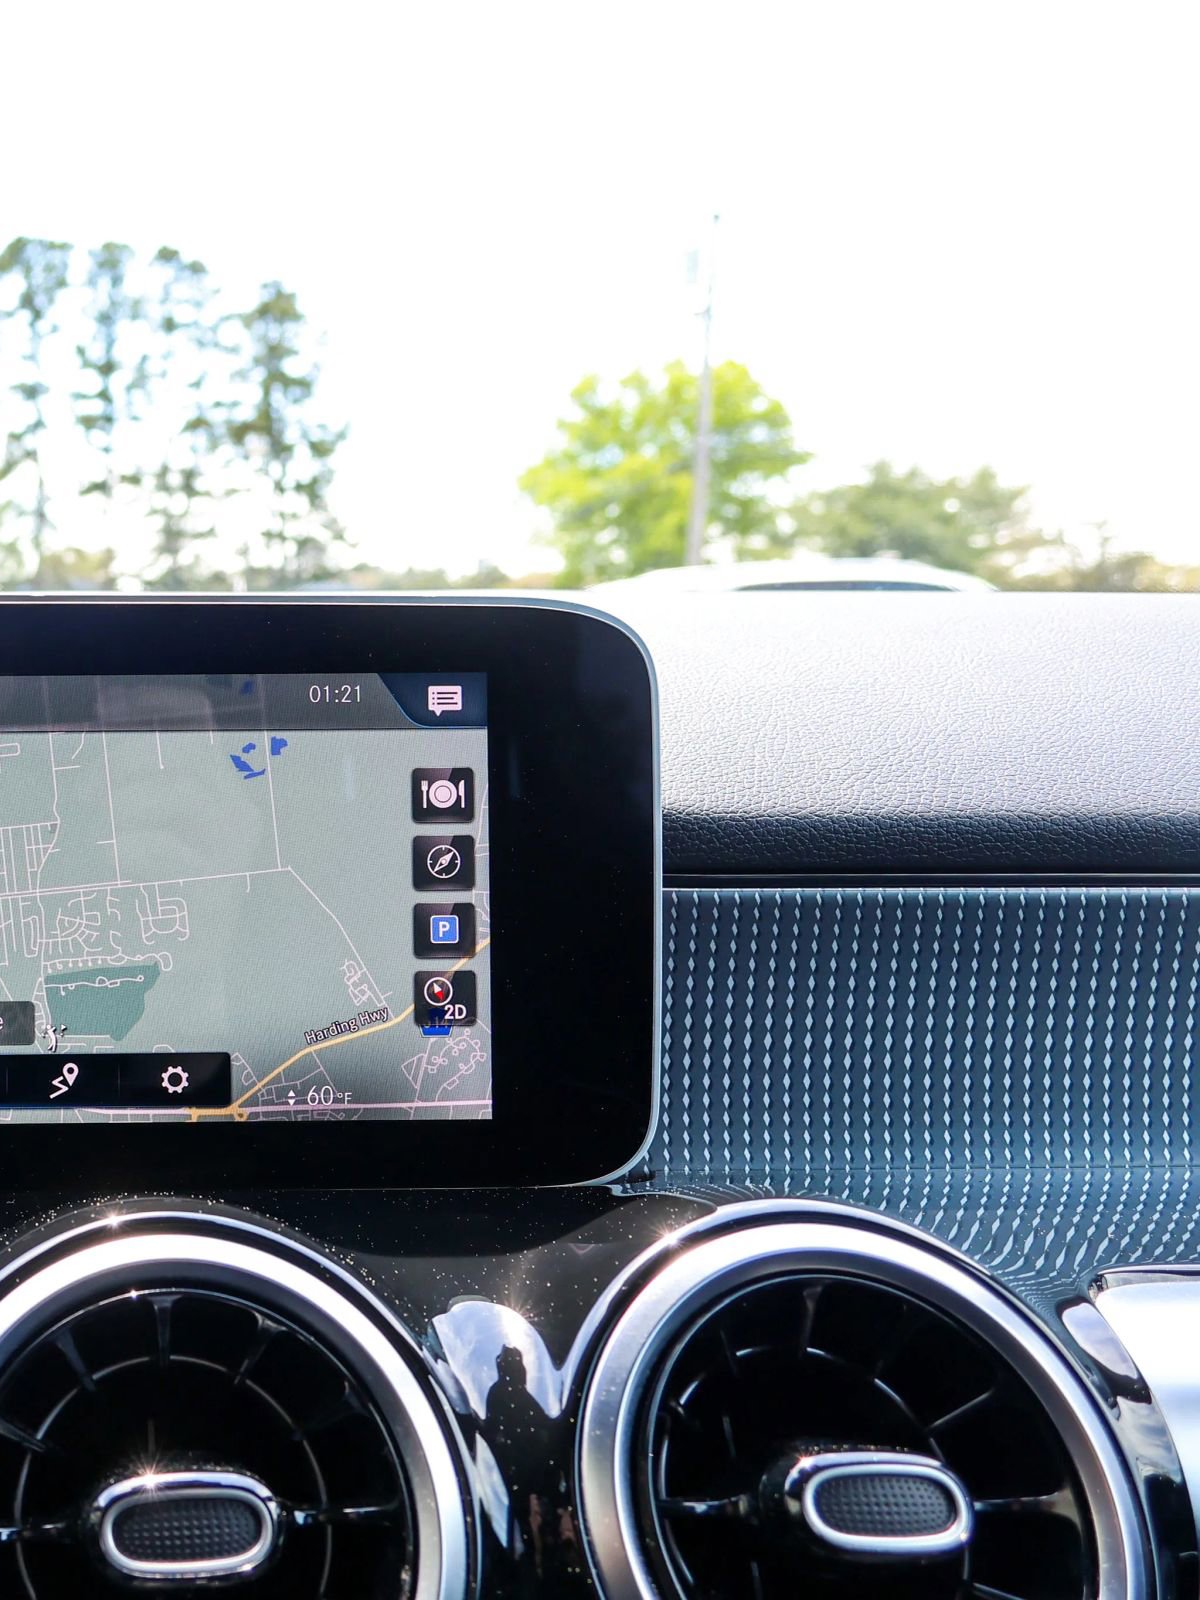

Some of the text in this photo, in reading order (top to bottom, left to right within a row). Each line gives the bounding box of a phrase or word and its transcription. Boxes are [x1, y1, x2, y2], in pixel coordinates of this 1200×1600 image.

[309, 684, 361, 703] 01:21
[438, 921, 450, 938] P
[444, 1004, 467, 1020] 2D
[304, 1007, 389, 1045] Harding Hwy
